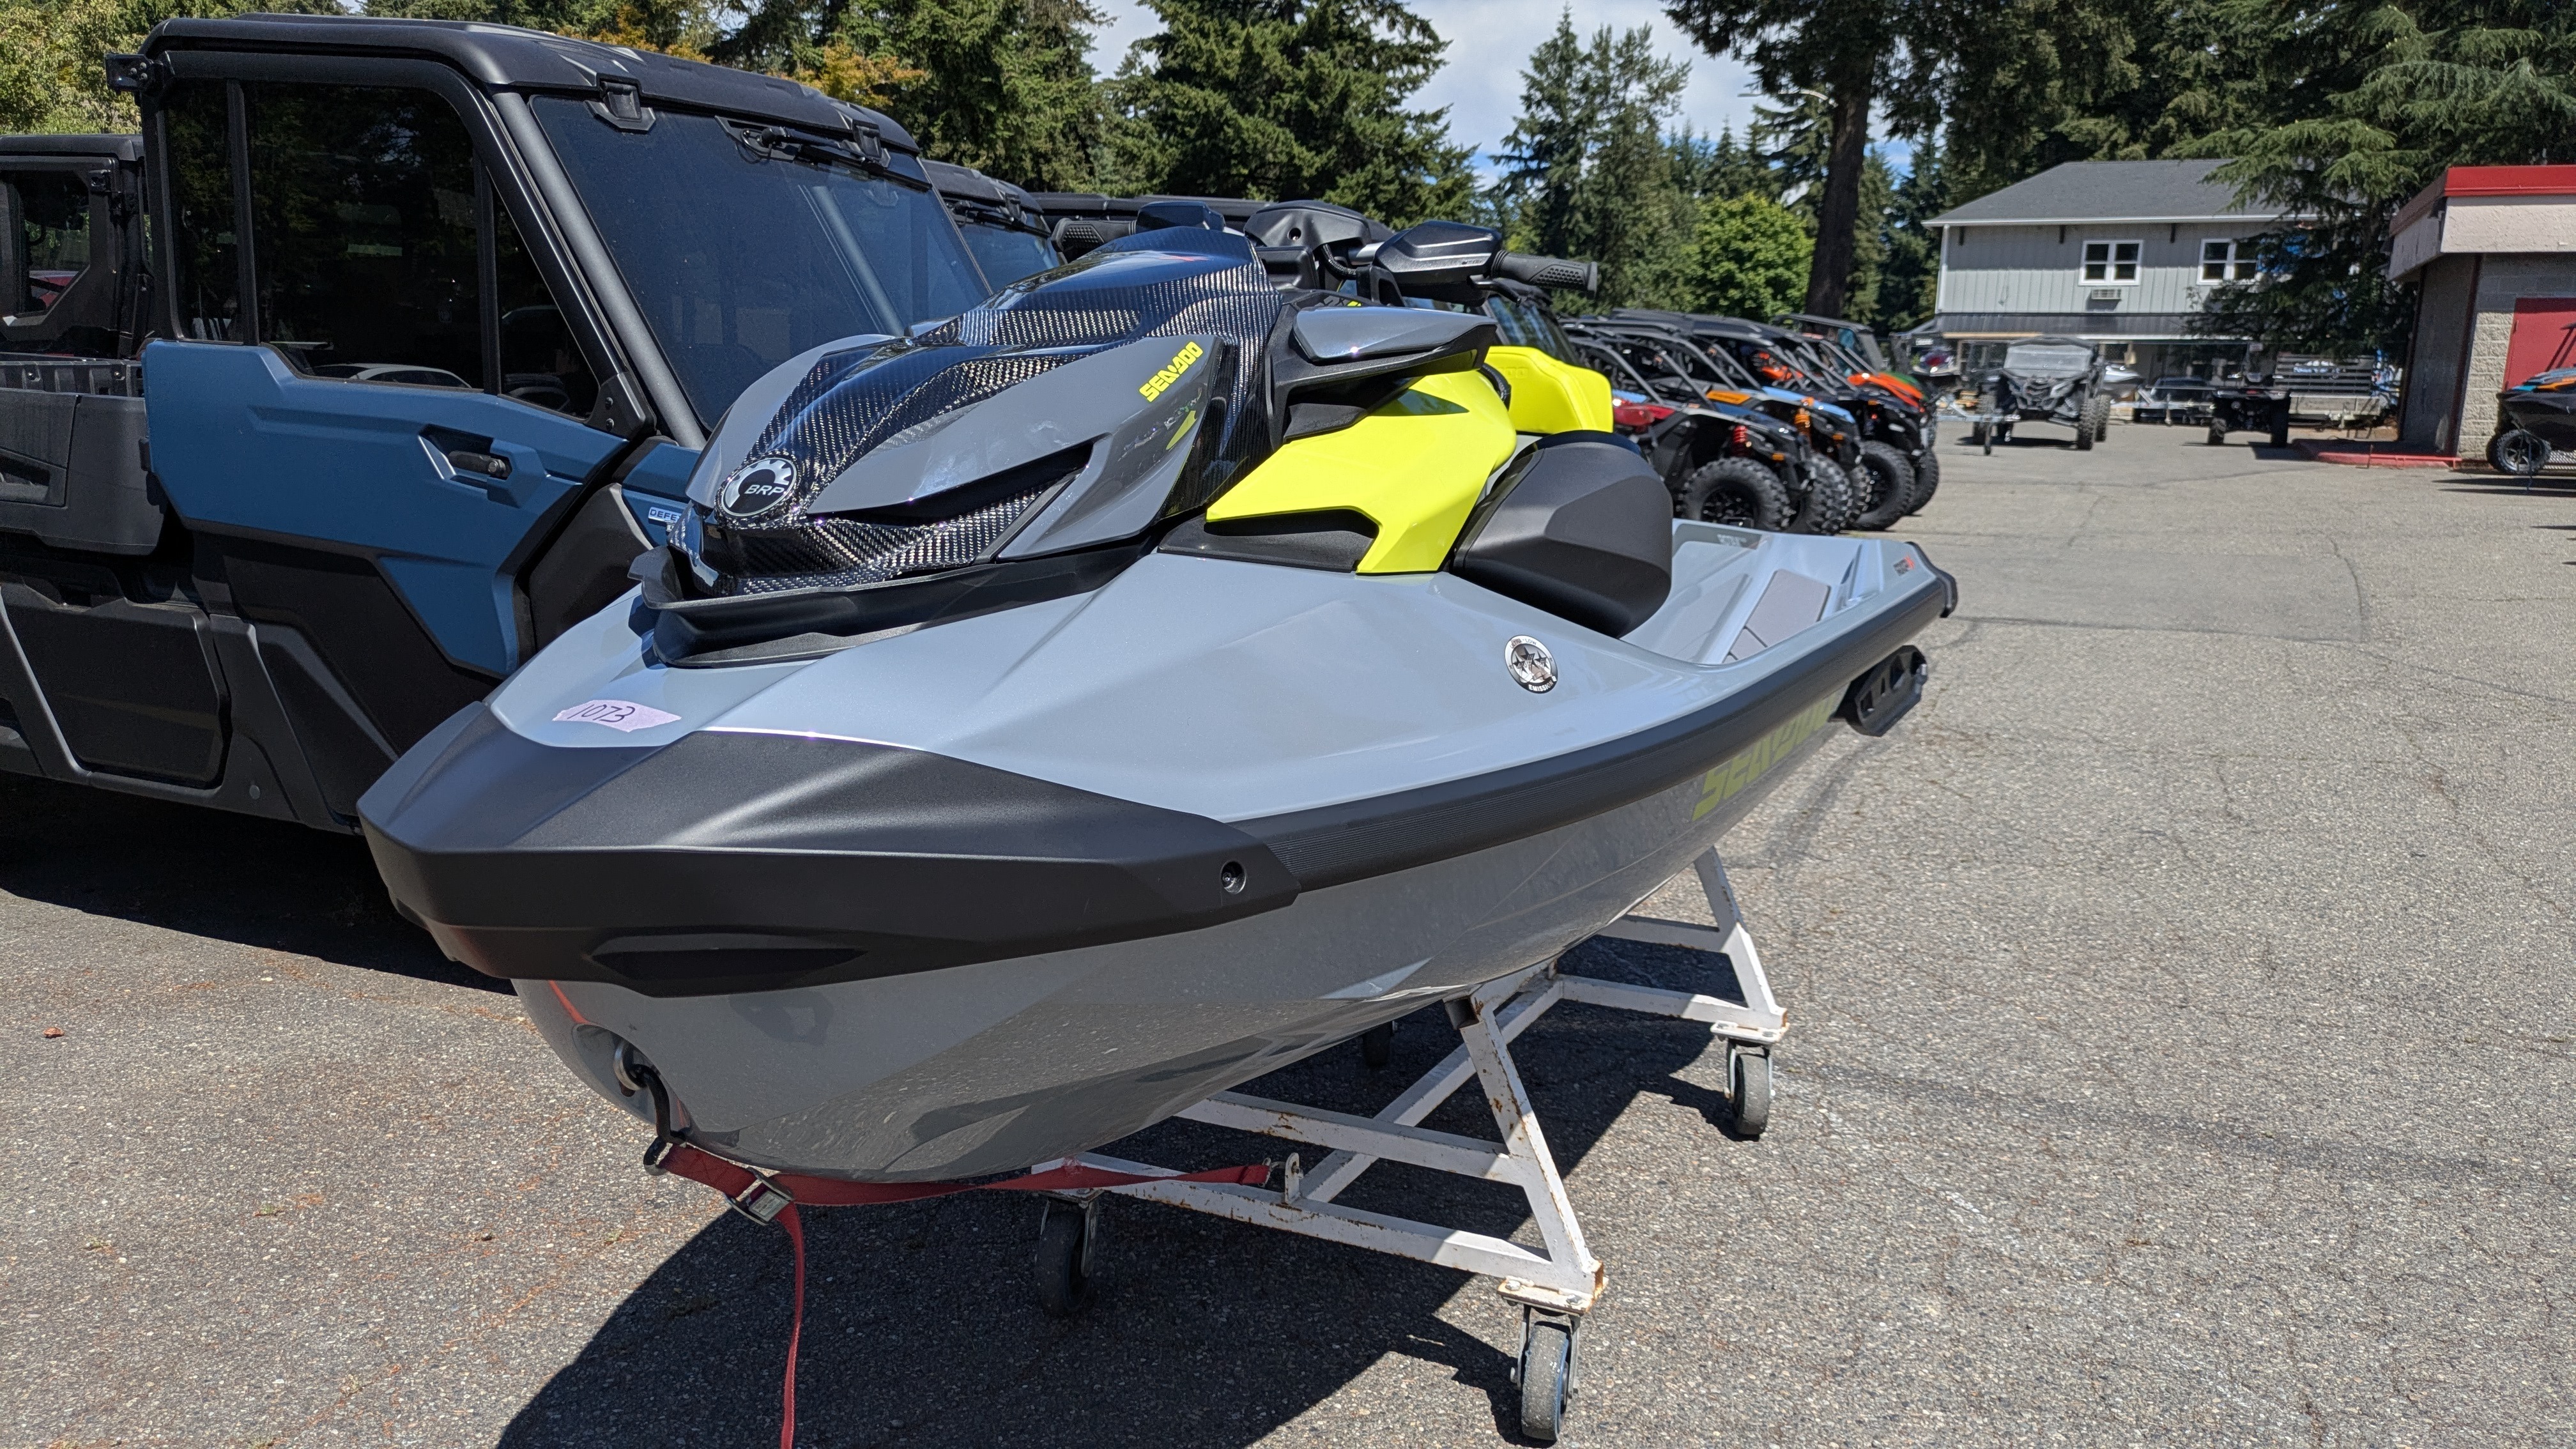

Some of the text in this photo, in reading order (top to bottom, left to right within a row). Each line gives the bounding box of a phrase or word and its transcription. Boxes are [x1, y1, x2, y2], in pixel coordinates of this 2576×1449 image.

[744, 484, 785, 496] BRP
[650, 509, 680, 521] DEFE
[1528, 680, 1554, 692] EMISSION
[567, 704, 636, 723] 1073
